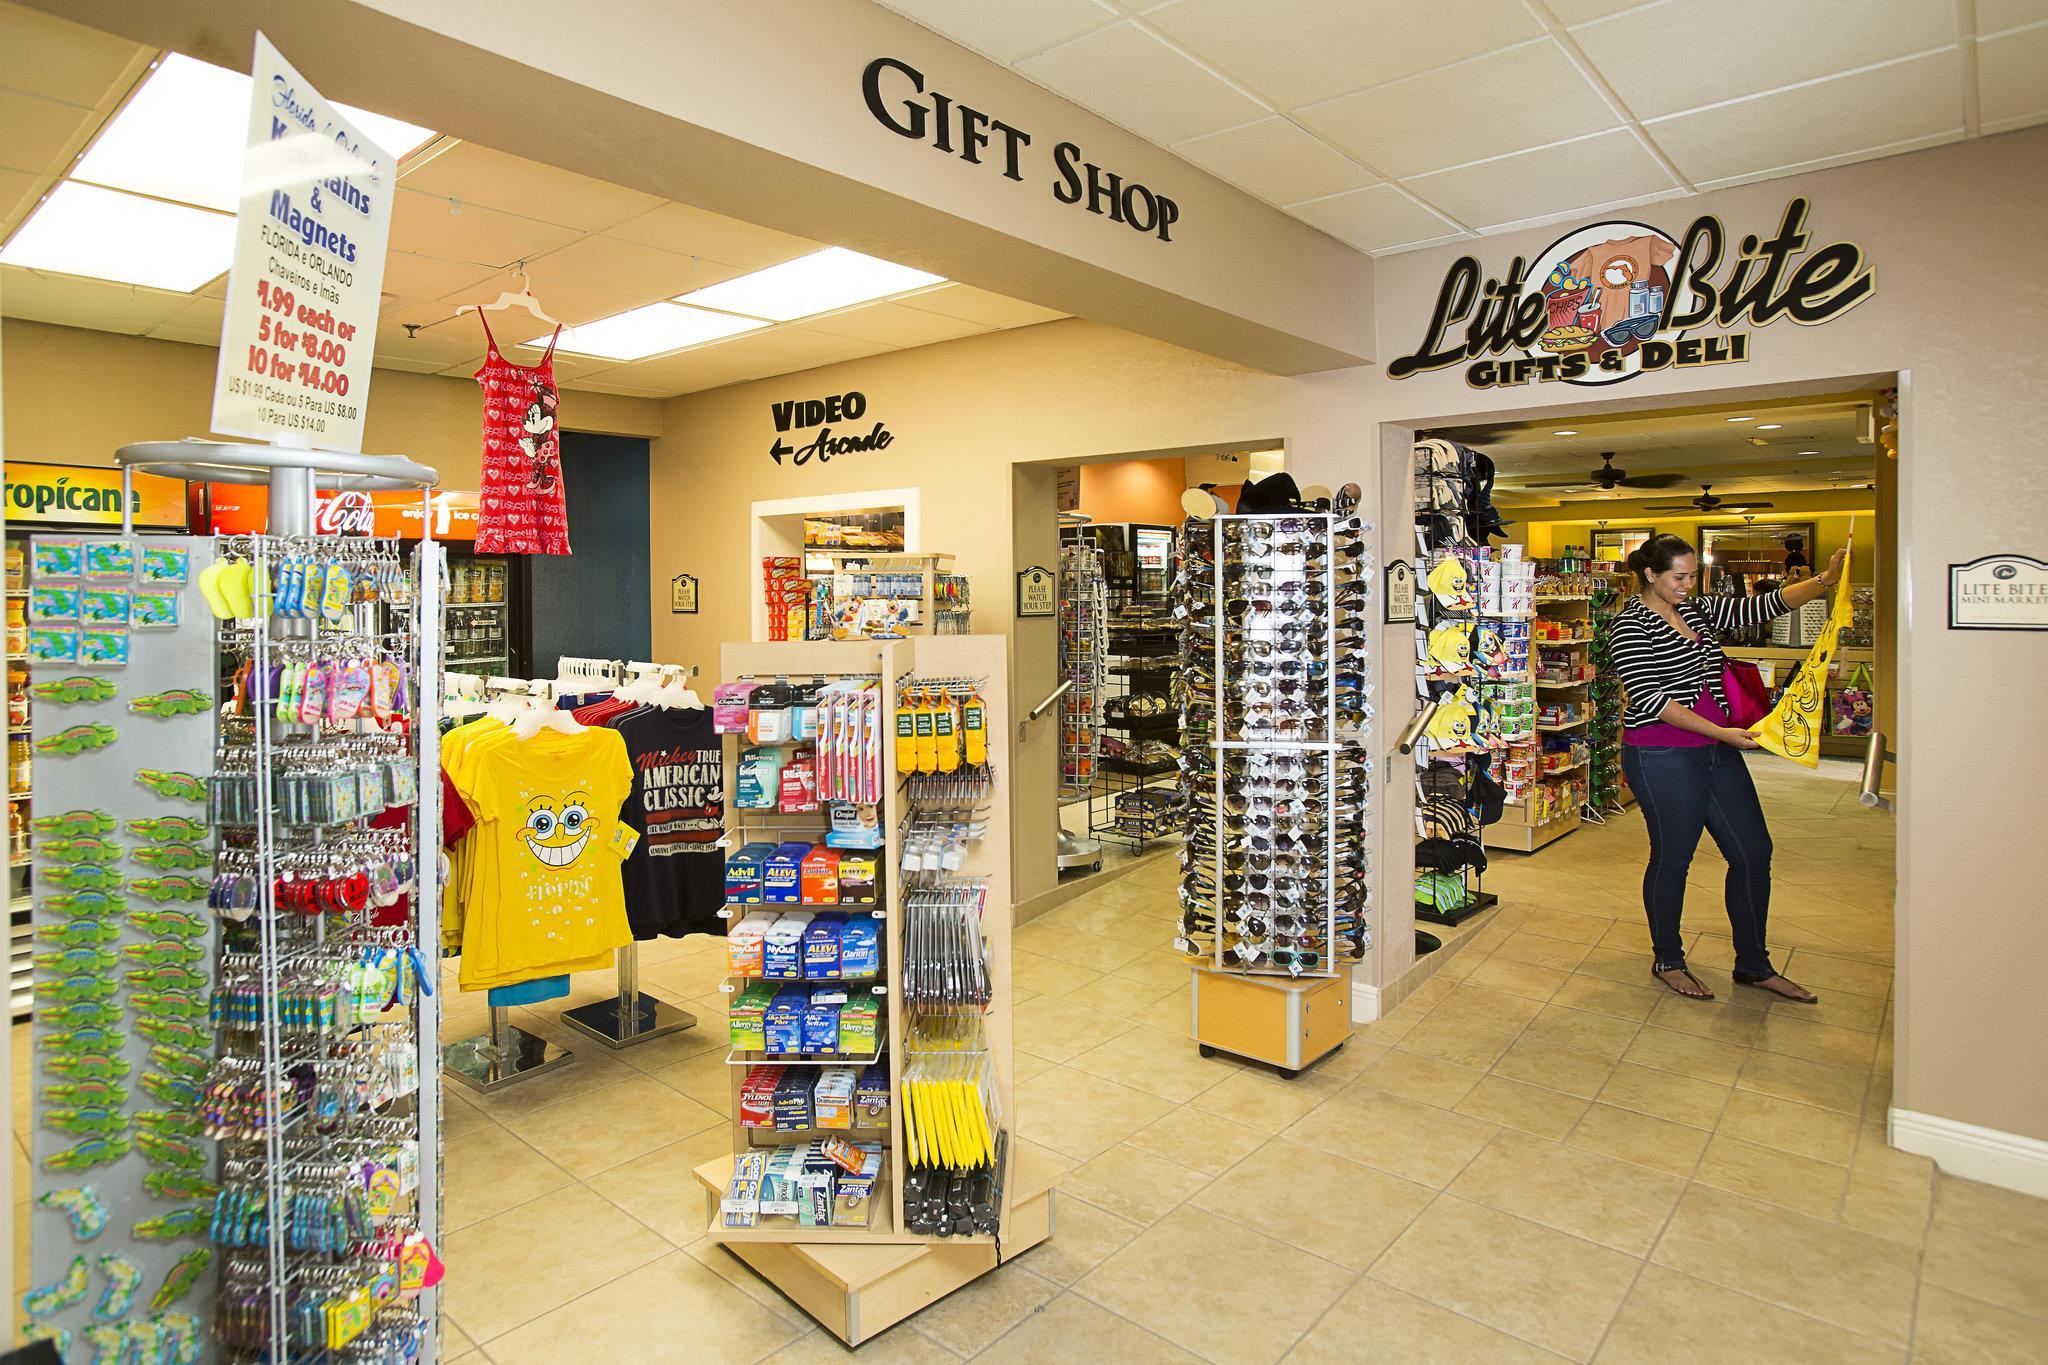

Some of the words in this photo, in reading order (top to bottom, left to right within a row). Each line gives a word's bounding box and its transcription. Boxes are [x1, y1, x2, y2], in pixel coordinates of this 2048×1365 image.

[861, 57, 1032, 182] GIFT
[1053, 141, 1179, 242] SHOP
[310, 186, 322, 214] &
[270, 188, 357, 263] Magnets
[261, 224, 301, 261] FLORIDA
[302, 252, 307, 265] e
[309, 255, 353, 287] ORLANDO
[268, 256, 311, 290] Chaveiros
[312, 282, 318, 295] e
[1387, 254, 1550, 381] Lite
[1656, 196, 1878, 334] Bite
[256, 278, 295, 318] $1.99
[297, 304, 336, 336] each
[338, 320, 357, 342] or
[258, 315, 271, 342] 5
[273, 321, 299, 352] for
[301, 331, 346, 368] $8.00
[247, 344, 268, 375] 10
[270, 352, 296, 383] for
[1465, 350, 1590, 390] GIFTS
[1599, 345, 1627, 374] &
[1638, 332, 1752, 371] DELI
[264, 385, 285, 405] Cada
[298, 394, 304, 409] 5
[304, 398, 323, 414] Para
[324, 402, 336, 416] US
[771, 391, 867, 433] VIDEO
[256, 407, 267, 422] 10
[268, 409, 286, 427] Para
[287, 414, 299, 429] US
[793, 421, 895, 466] Arcade
[1028, 585, 1047, 593] PLEASE
[1028, 593, 1047, 601] WATCH
[1962, 583, 2002, 595] LITE
[2009, 583, 2048, 595] BITE
[1023, 602, 1039, 610] YOUR
[1039, 602, 1052, 610] STEP
[636, 746, 697, 773] Mickey
[696, 750, 721, 764] TRUE
[643, 764, 721, 791] AMERICAN
[643, 786, 706, 812] CLASSIC
[726, 867, 755, 877] Advil
[766, 867, 798, 878] ALEVE
[808, 943, 839, 954] ALEVE
[741, 1092, 774, 1101] TYLENOL
[815, 1191, 826, 1222] Zantac
